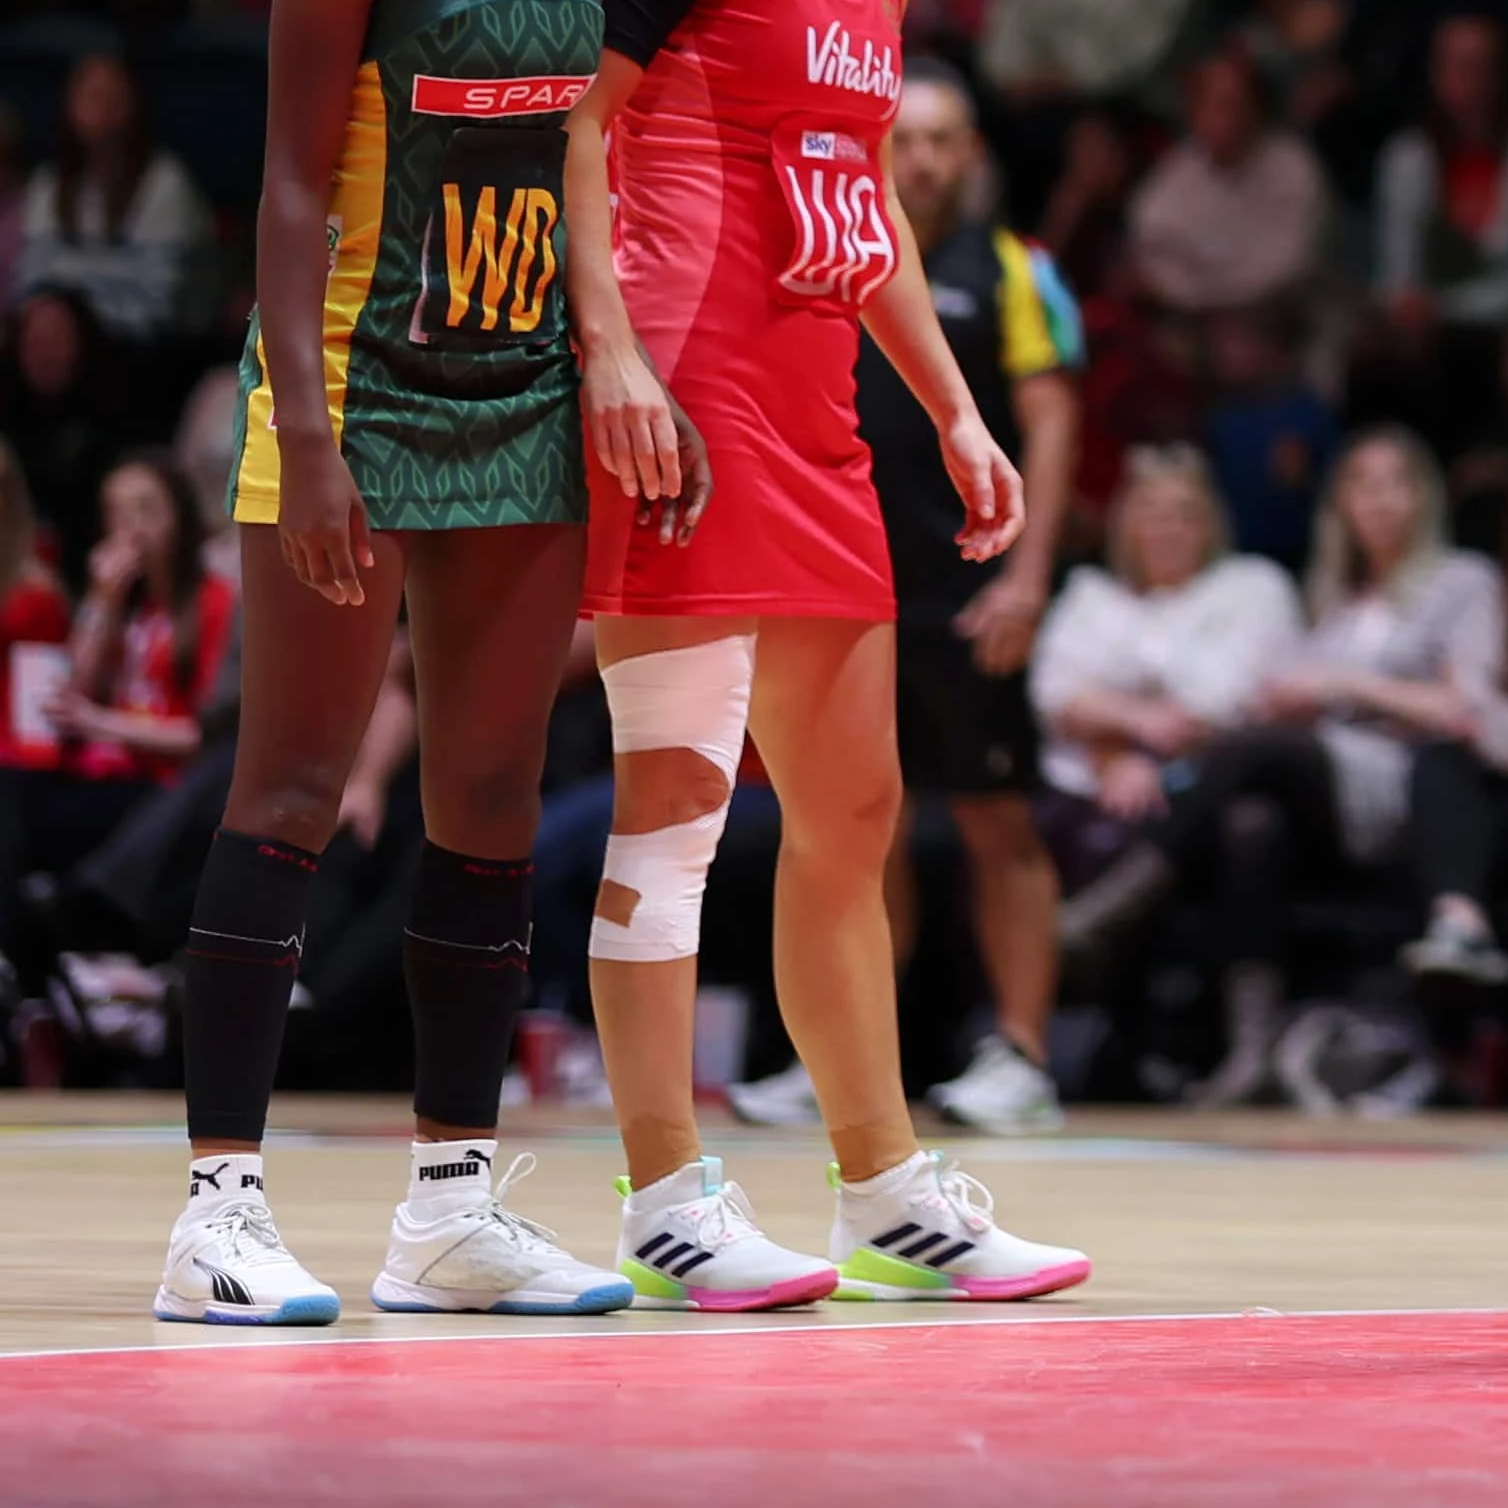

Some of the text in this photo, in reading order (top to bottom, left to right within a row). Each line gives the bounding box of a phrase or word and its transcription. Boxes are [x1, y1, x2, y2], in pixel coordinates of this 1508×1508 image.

[463, 83, 584, 110] SPAR
[806, 20, 901, 122] Vitality
[442, 182, 558, 333] WD
[778, 164, 895, 305] WA
[419, 1161, 479, 1181] PUMA
